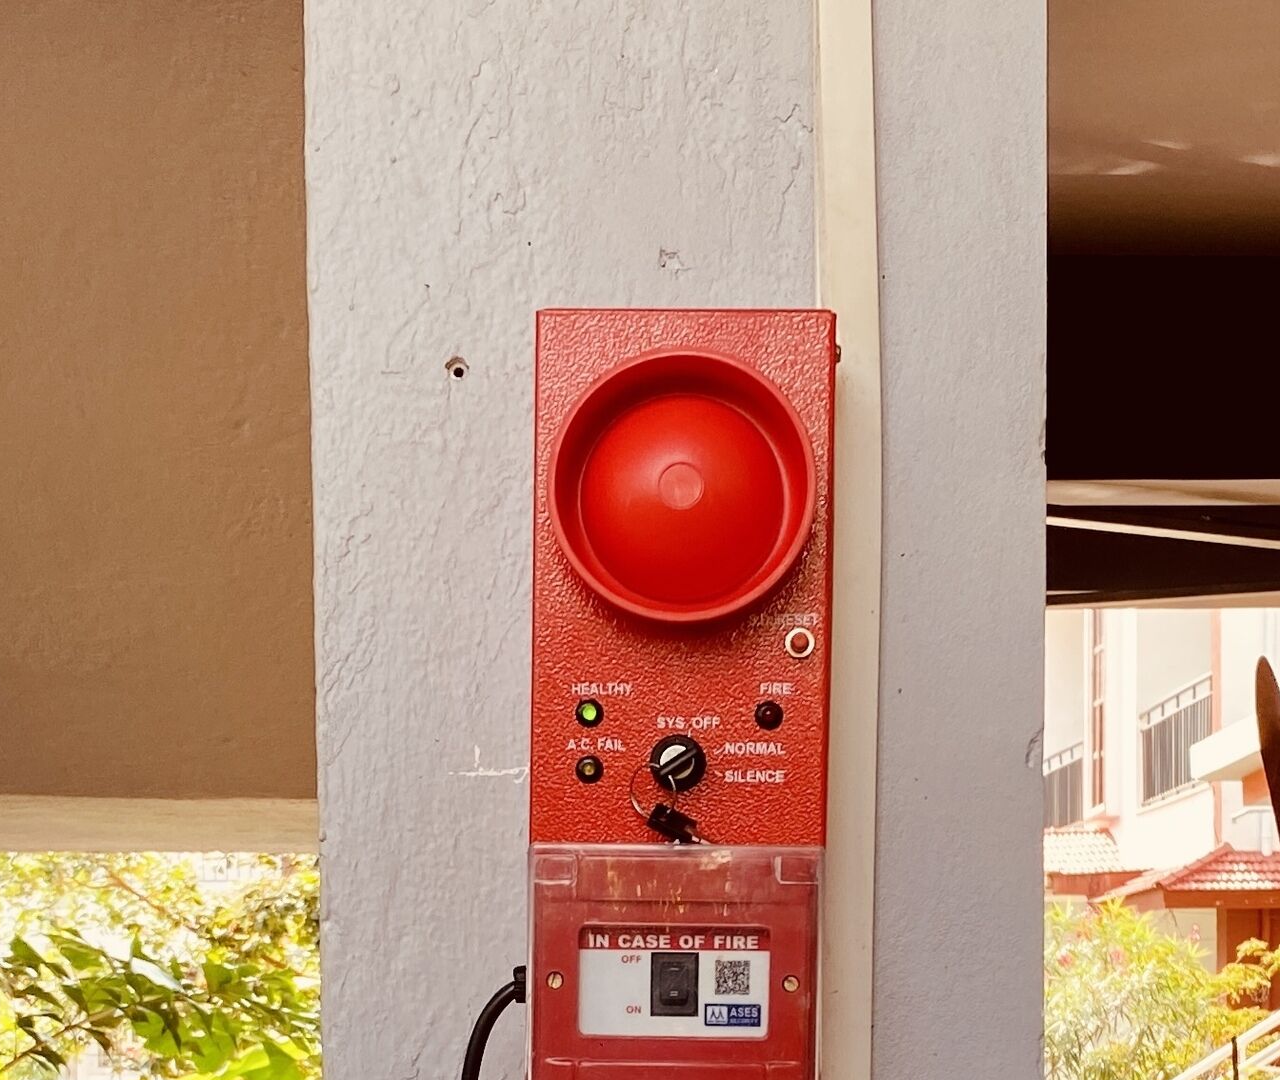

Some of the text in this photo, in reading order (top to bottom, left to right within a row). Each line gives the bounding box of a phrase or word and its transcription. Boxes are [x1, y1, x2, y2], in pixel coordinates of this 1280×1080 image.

[571, 683, 632, 695] HEALTHY
[760, 683, 791, 694] FIRE
[692, 716, 720, 730] OFF
[597, 737, 626, 751] FAIL
[724, 742, 785, 755] NORMAL
[724, 770, 786, 783] SILENCE
[588, 933, 759, 949] IN CASE OF FIRE
[621, 955, 642, 963] OFF
[626, 1005, 642, 1014] ON
[730, 1007, 758, 1017] ASES
